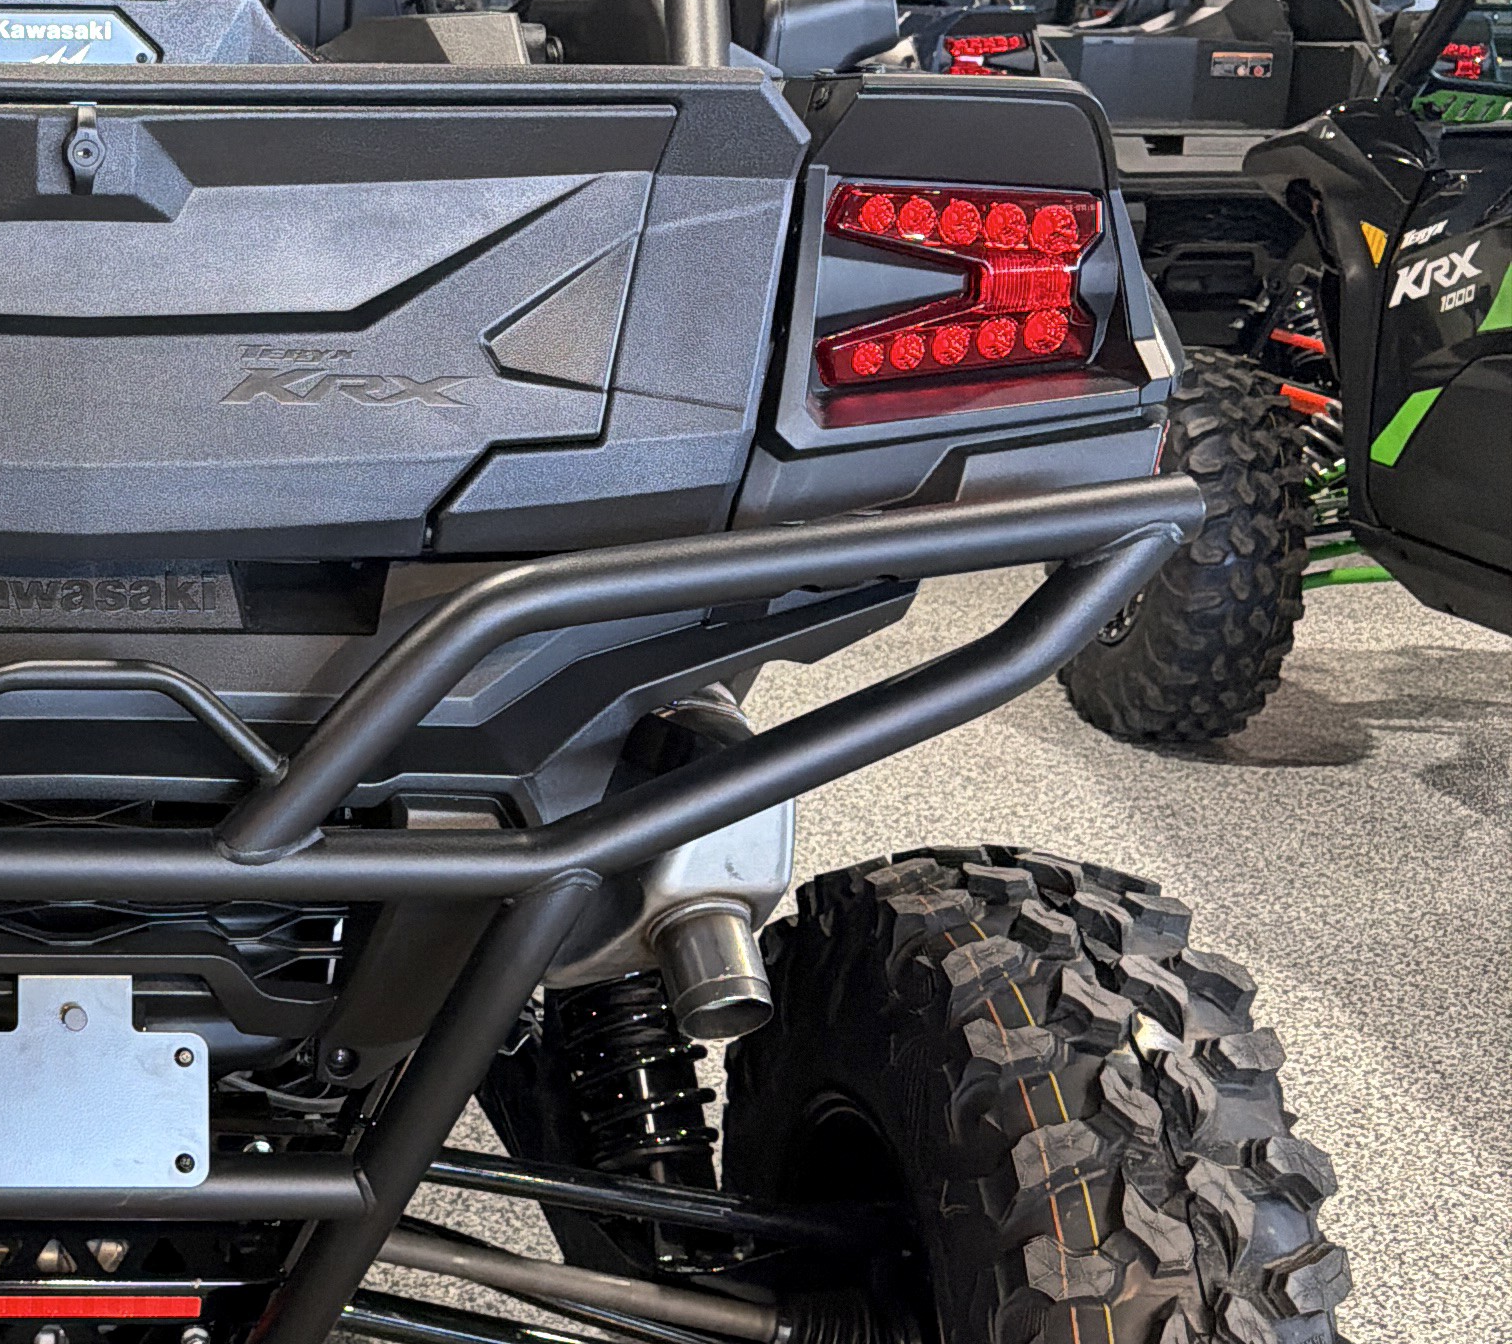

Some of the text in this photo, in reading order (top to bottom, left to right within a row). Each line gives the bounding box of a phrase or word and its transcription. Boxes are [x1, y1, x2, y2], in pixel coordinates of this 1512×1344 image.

[1388, 239, 1483, 309] KRX
[1439, 283, 1476, 313] 1000
[219, 367, 479, 407] KRX
